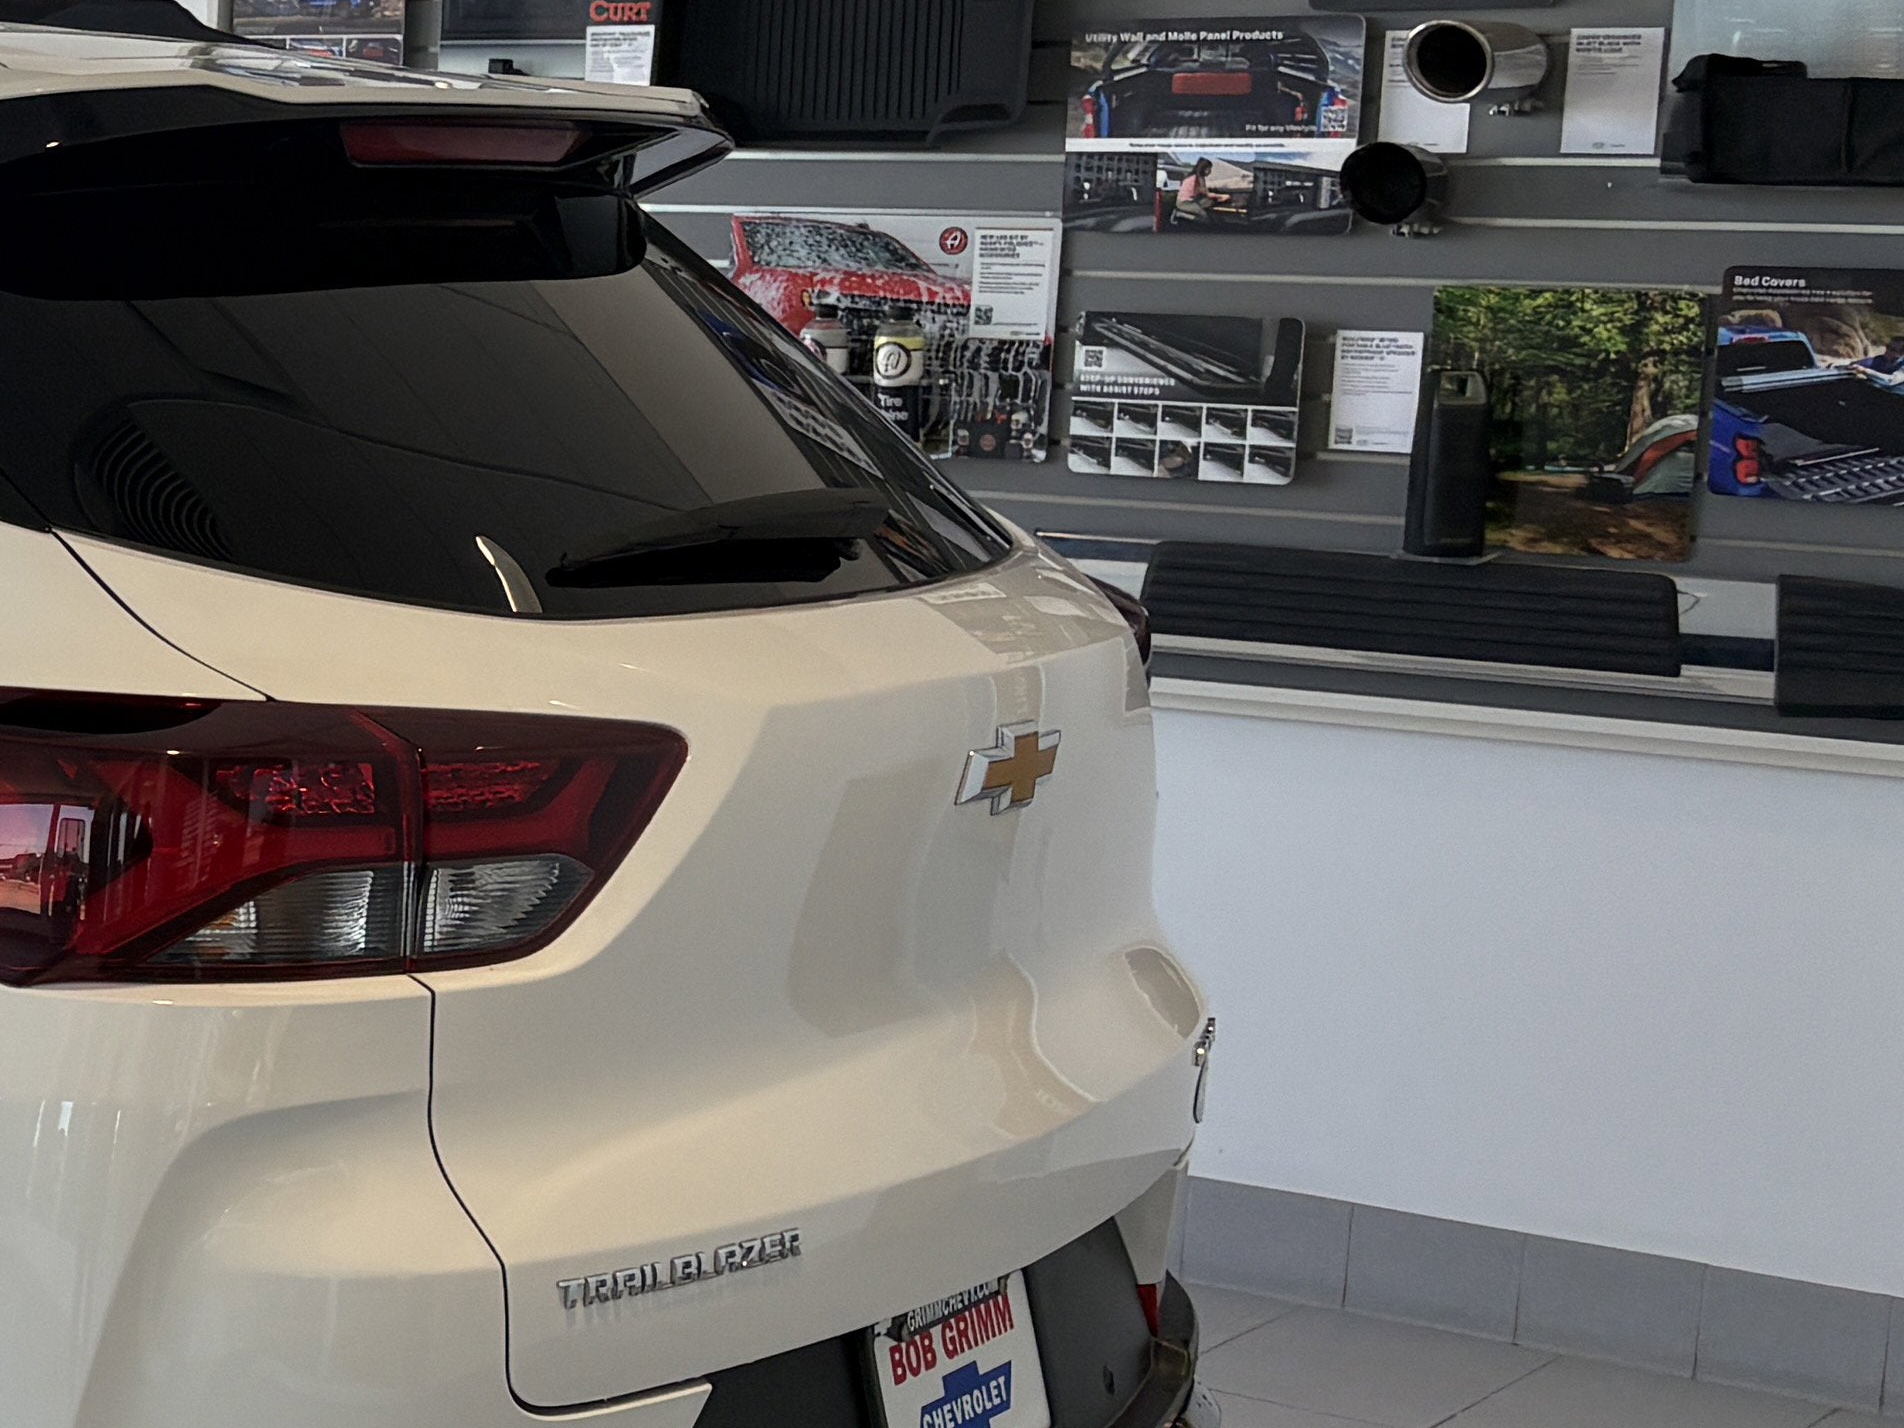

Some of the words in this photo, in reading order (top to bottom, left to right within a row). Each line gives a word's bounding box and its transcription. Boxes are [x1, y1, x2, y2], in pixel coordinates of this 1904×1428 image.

[1085, 33, 1118, 43] Utility
[1120, 32, 1143, 42] Wall
[1146, 31, 1166, 41] and
[1167, 31, 1198, 41] Molle
[1199, 30, 1231, 40] Panel
[1232, 30, 1284, 40] Products
[1734, 275, 1759, 286] Bed
[1761, 276, 1806, 287] Covers
[877, 393, 903, 407] Tire
[556, 1227, 802, 1310] TRAILBLAZER
[889, 1328, 937, 1387] BOB
[941, 1291, 1015, 1360] GRIMM
